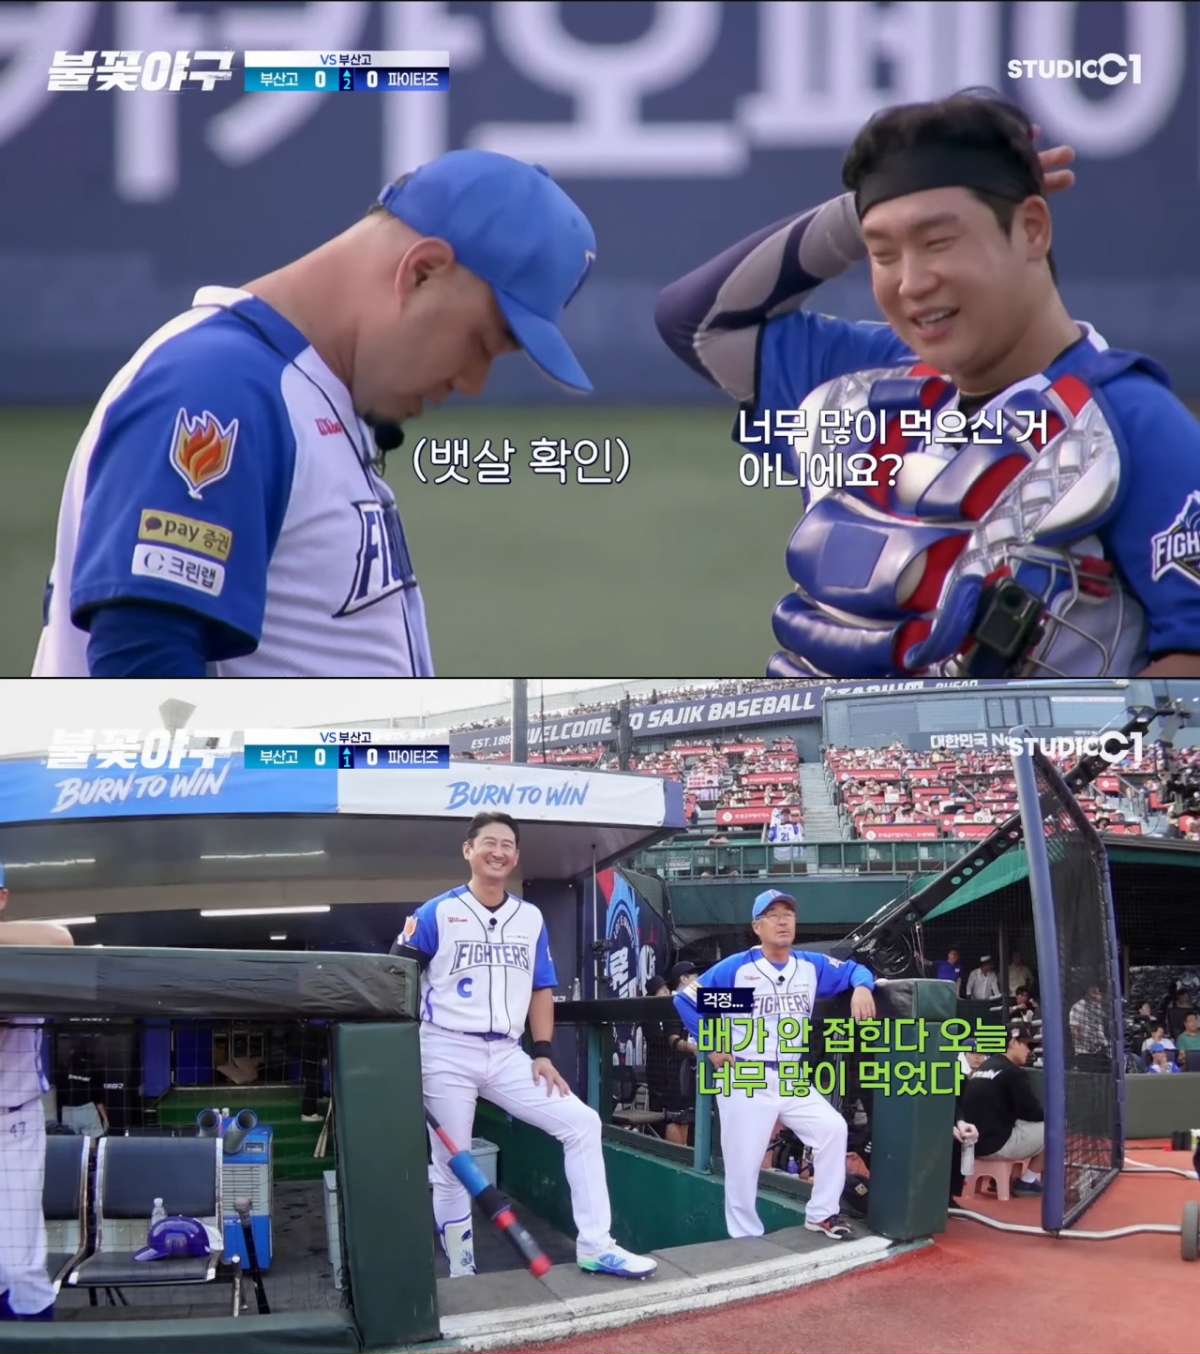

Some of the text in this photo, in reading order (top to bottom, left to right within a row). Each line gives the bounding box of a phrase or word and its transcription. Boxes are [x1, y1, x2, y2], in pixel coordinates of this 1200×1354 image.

[164, 520, 230, 555] pay 증권
[168, 556, 217, 589] 크린랩
[471, 735, 512, 750] EST.198
[526, 718, 612, 745] WELCOME
[647, 704, 706, 728] SAJIK
[707, 692, 816, 722] BASEBALL
[930, 732, 988, 749] 대한민국
[50, 759, 234, 813] BURN TO WIN
[444, 779, 591, 810] BURN TO WIN
[455, 943, 530, 971] FIGHTERS
[457, 977, 473, 998] C
[10, 1121, 26, 1138] 47
